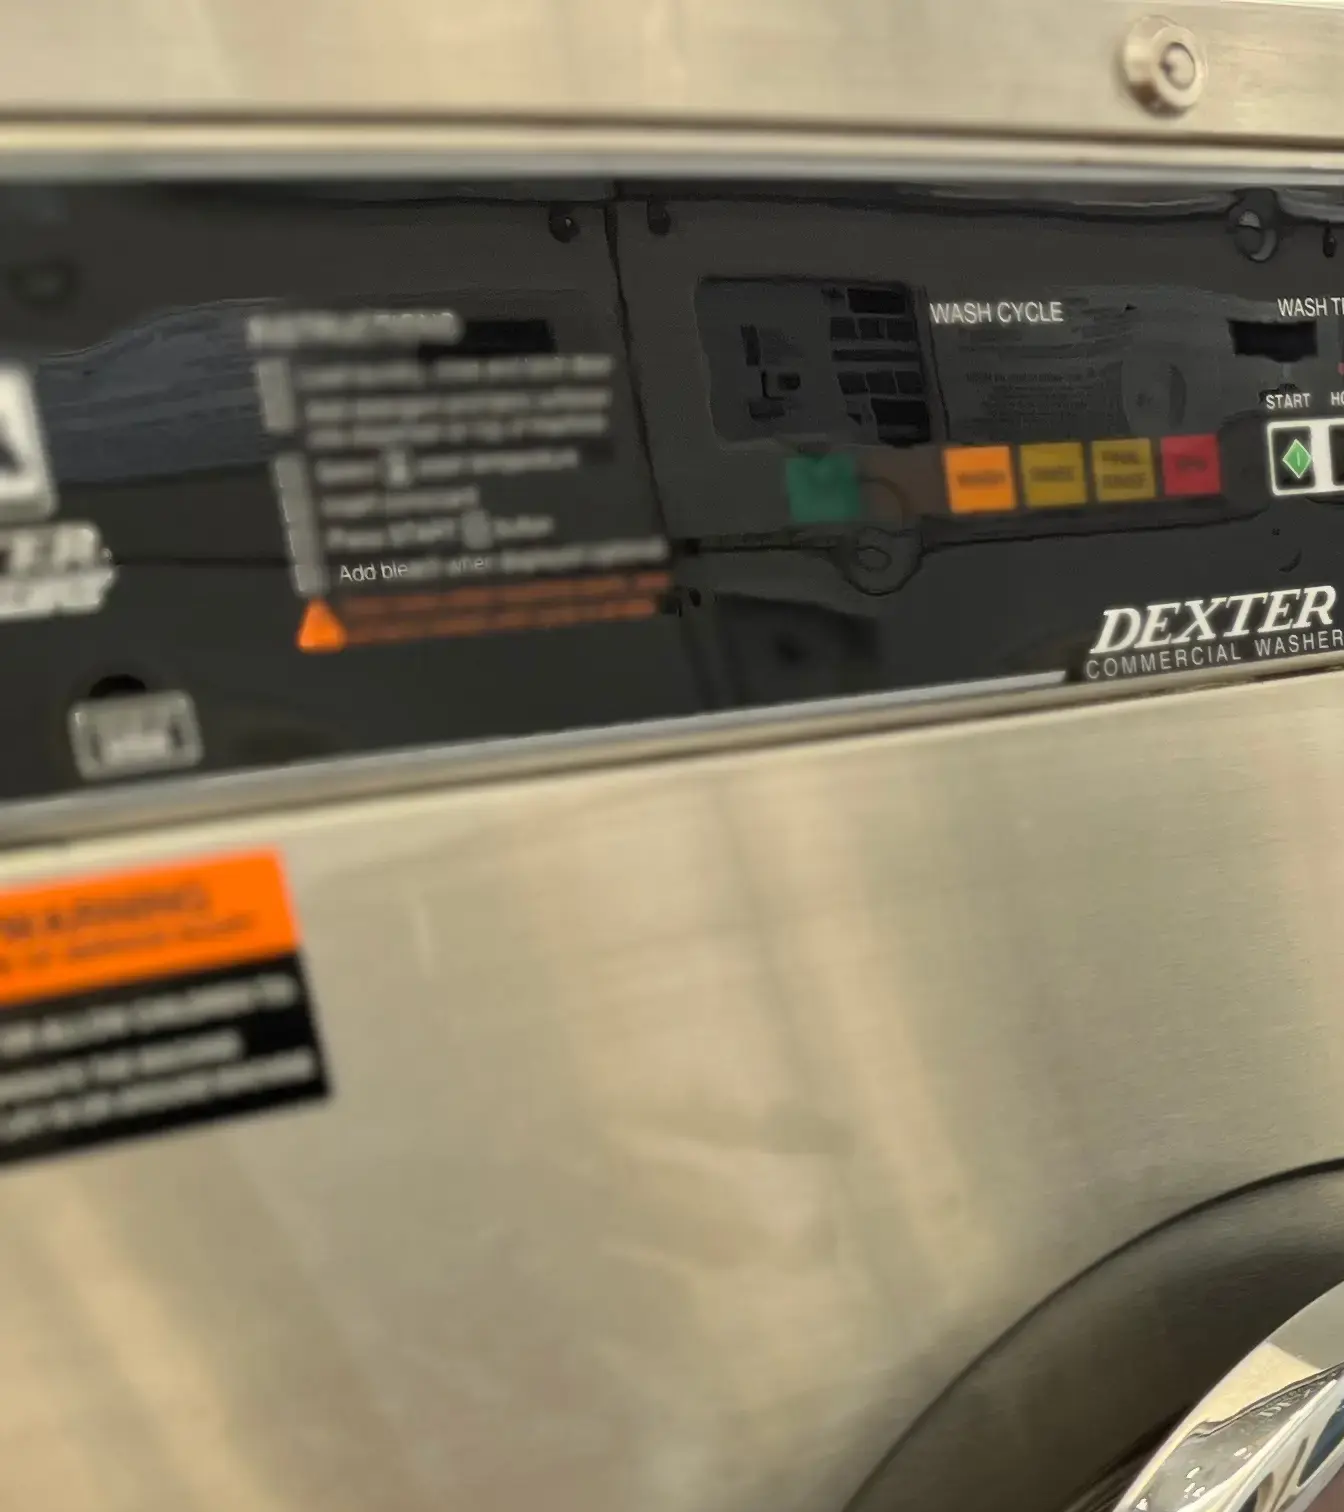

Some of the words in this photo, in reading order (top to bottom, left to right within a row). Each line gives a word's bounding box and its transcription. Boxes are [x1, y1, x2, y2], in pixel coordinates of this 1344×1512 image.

[930, 302, 991, 324] WASH
[997, 302, 1063, 323] CYCLE
[1277, 297, 1328, 316] WASH
[1266, 393, 1310, 409] START
[339, 564, 377, 582] Add
[1089, 585, 1336, 654] DEXTER
[1086, 644, 1241, 679] COMMERCIAL
[1255, 629, 1344, 657] WASHER
